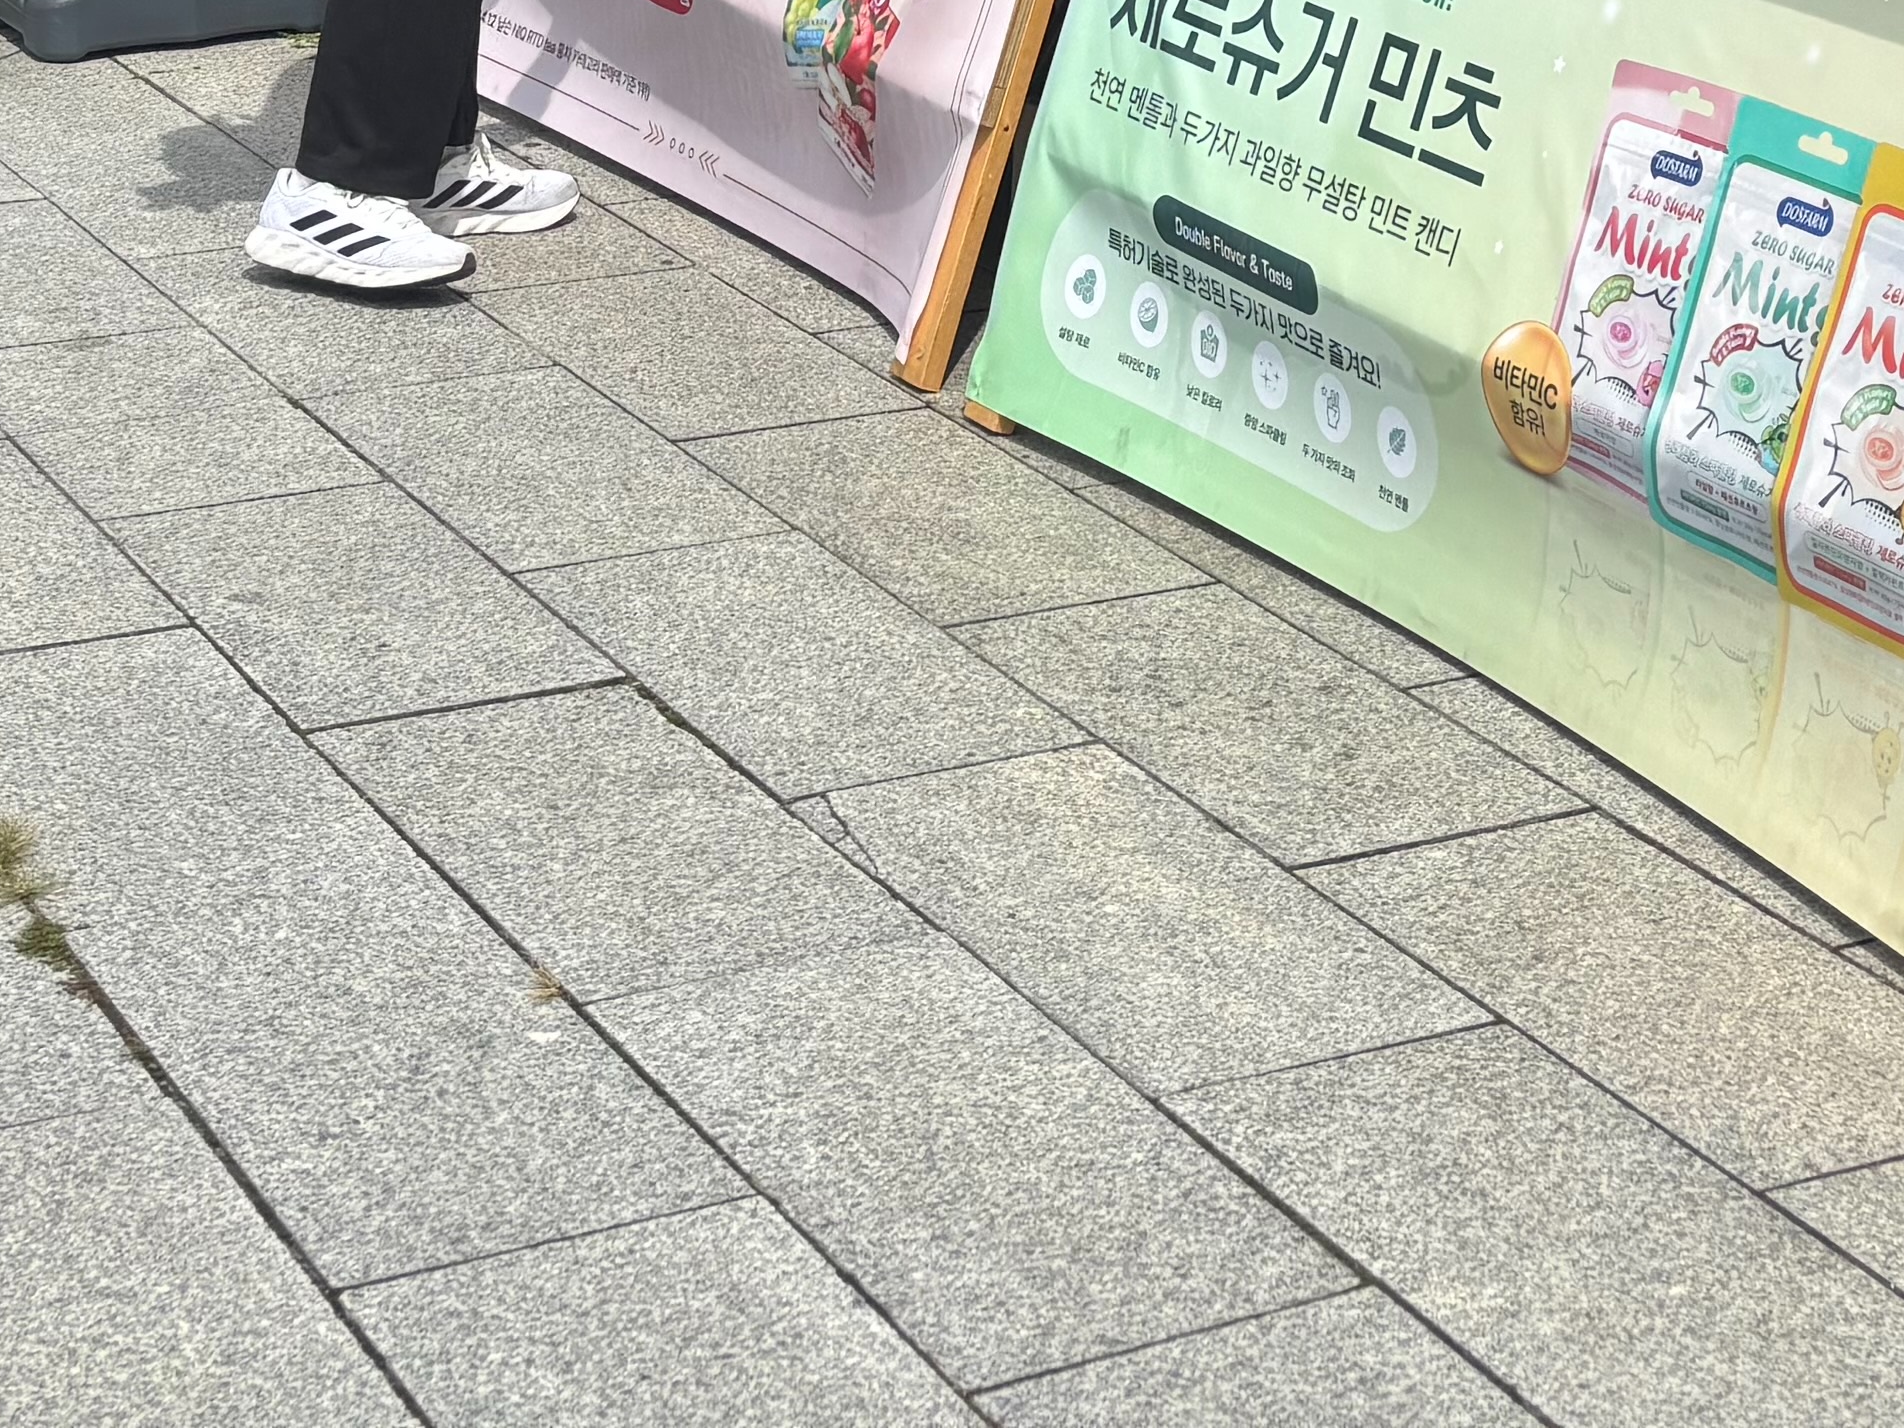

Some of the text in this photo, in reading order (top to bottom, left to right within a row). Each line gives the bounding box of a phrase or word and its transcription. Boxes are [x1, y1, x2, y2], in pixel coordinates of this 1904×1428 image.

[1357, 31, 1502, 187] 민츠
[1089, 66, 1463, 268] 천연 멘톨과 두가지 과일향 무설탕 민트 캔디
[1627, 184, 1705, 224] ZERO SUGAR
[1174, 215, 1295, 292] Double Flavor & Taste
[1594, 206, 1696, 282] Mint
[1751, 230, 1835, 276] ZERO SUGAR
[1107, 227, 1382, 391] 특허기술로 완성된 두가지 맛으로 즐겨요!
[1494, 356, 1558, 411] 비타민C
[1509, 399, 1547, 437] 함유!
